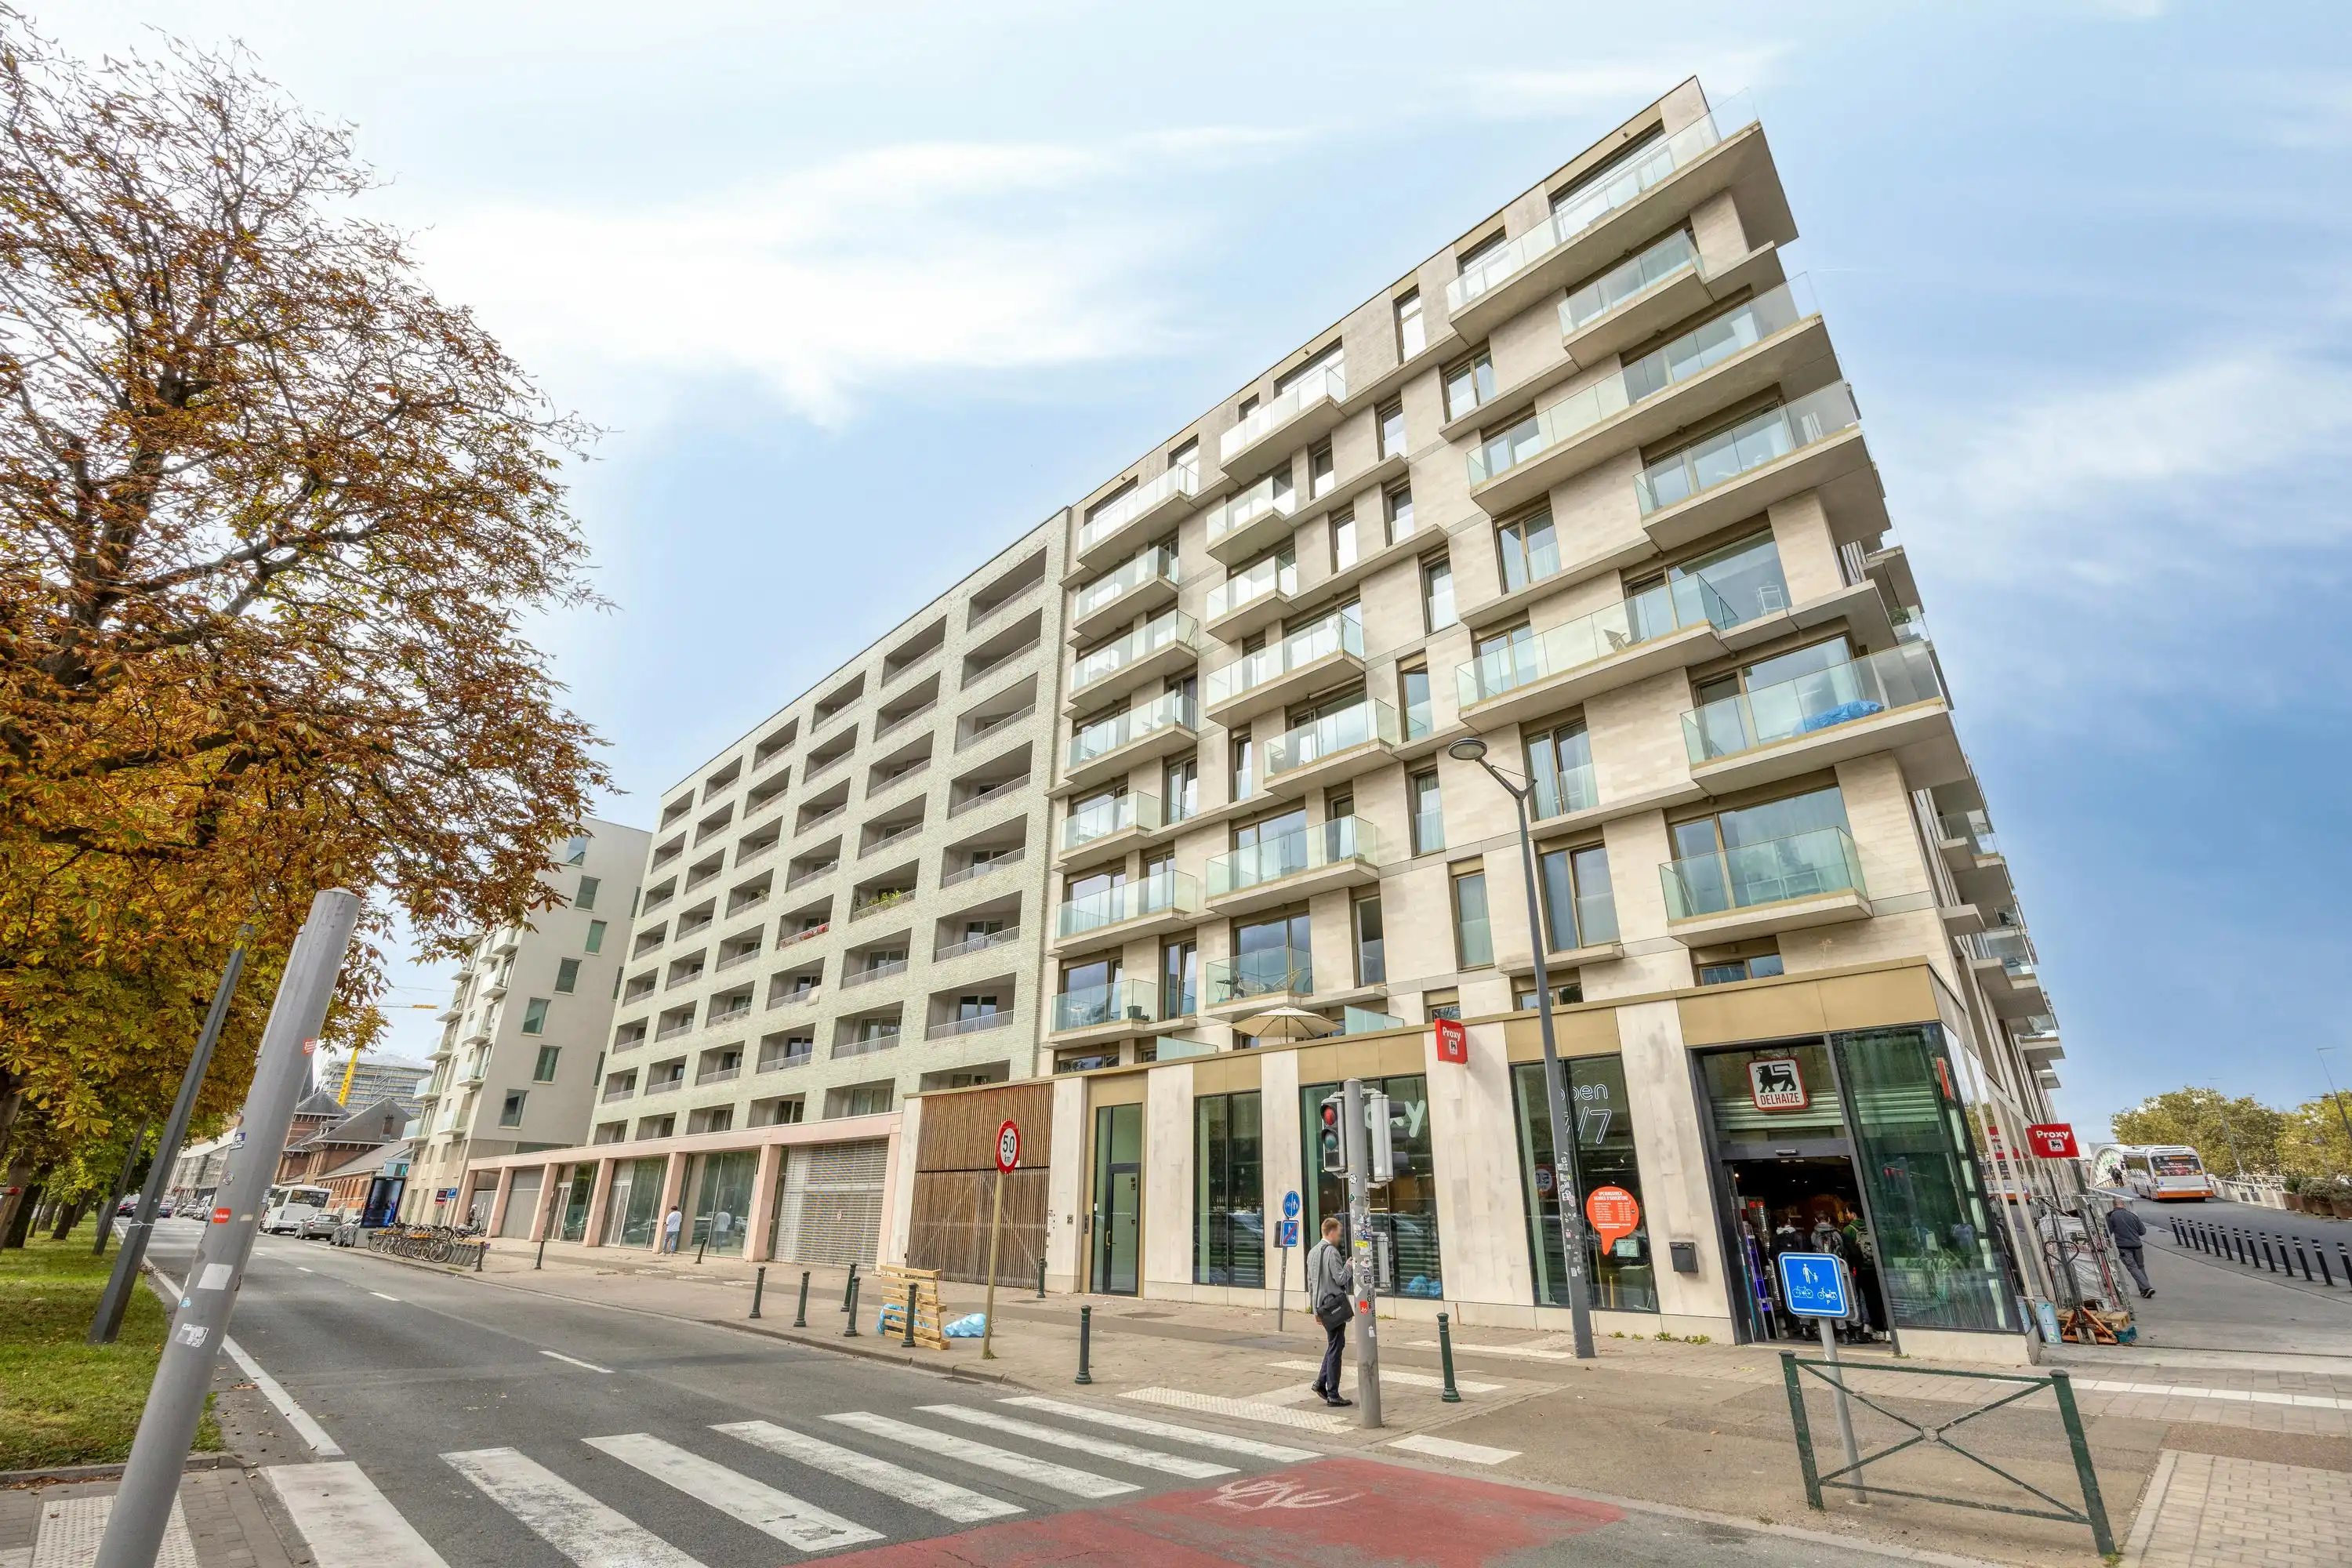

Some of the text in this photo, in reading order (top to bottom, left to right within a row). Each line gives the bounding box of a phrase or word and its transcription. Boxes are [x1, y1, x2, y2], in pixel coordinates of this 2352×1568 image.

[1443, 1026, 1461, 1042] Proxy
[1760, 1093, 1800, 1105] DELHAIZE
[2036, 1130, 2069, 1139] Proxy
[1003, 1134, 1014, 1153] 50
